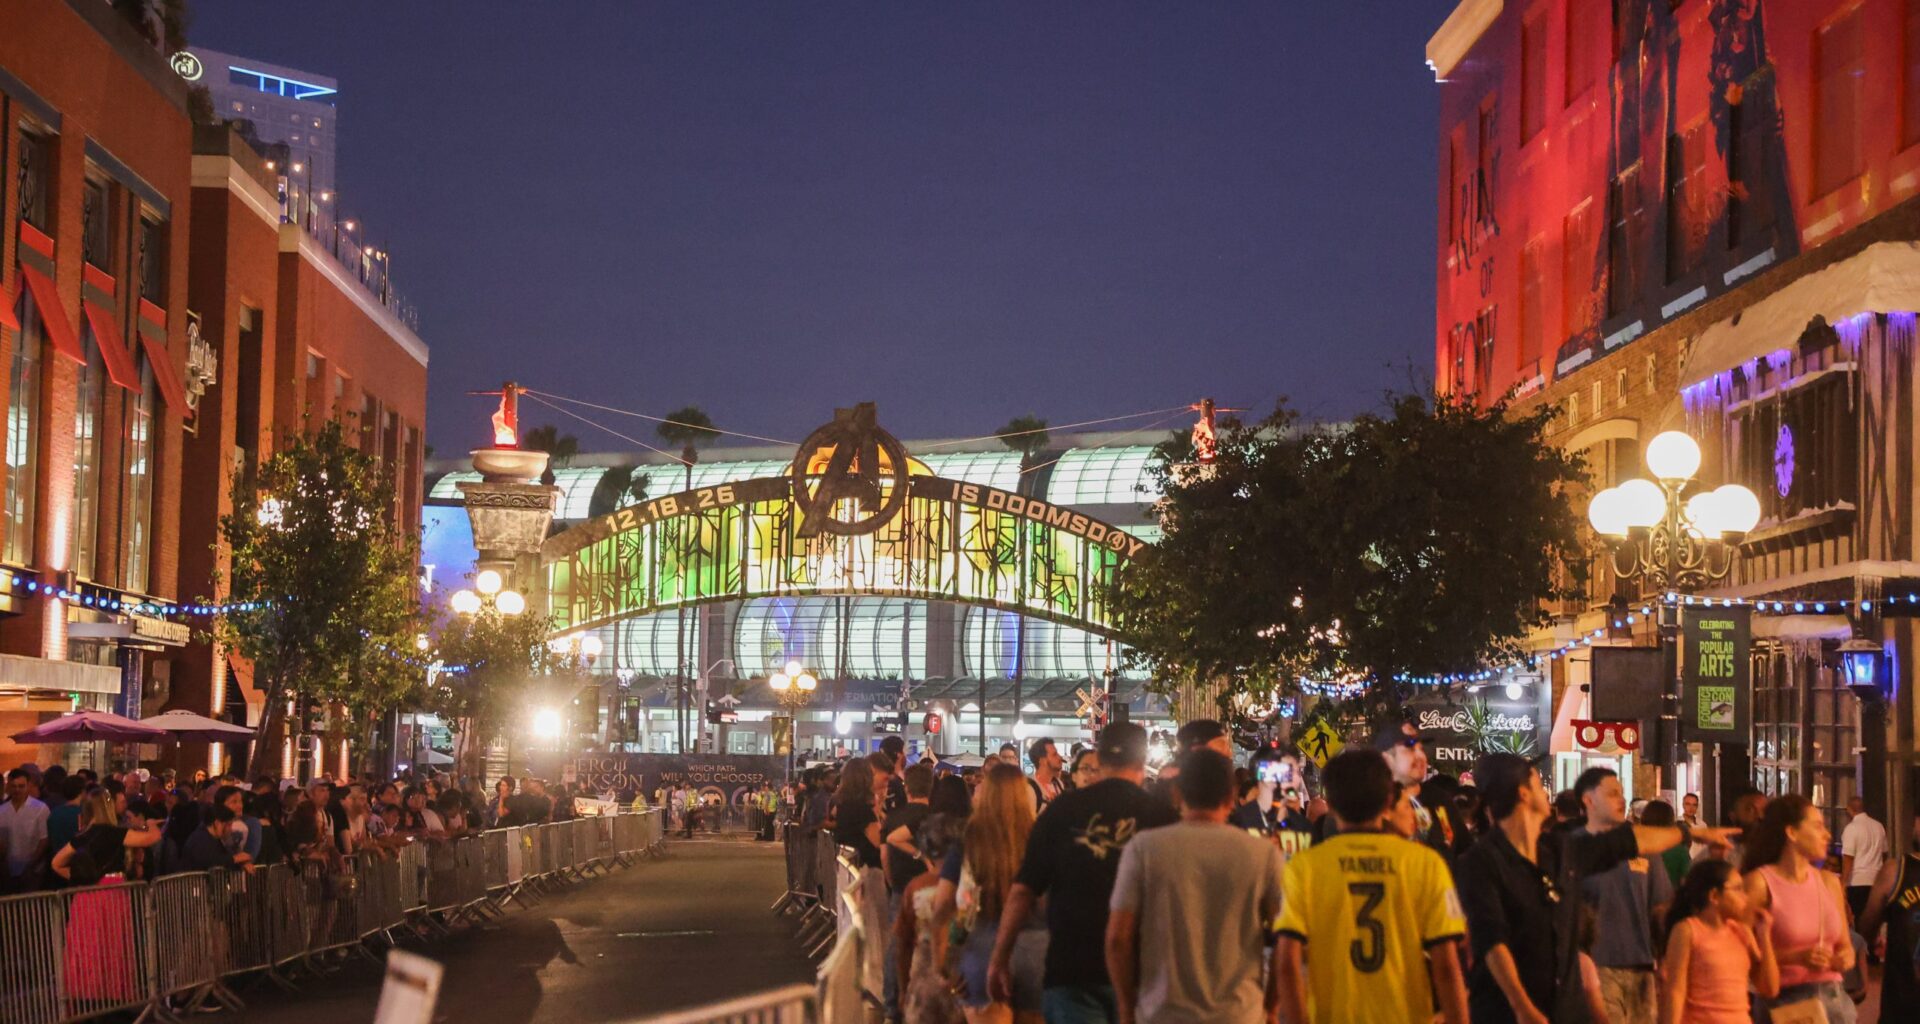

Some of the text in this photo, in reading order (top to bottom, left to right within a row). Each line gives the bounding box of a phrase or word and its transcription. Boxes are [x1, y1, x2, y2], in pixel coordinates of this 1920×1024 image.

[1480, 256, 1494, 298] OF
[952, 482, 980, 504] IS
[1699, 620, 1735, 630] CELEBRATING
[1711, 631, 1722, 639] THE
[1699, 641, 1734, 654] POPULAR
[1699, 654, 1734, 677] ARTS
[824, 693, 899, 703] IERNATION
[1712, 691, 1732, 702] CON
[1419, 710, 1451, 730] Lou
[687, 764, 736, 772] WHICH PATH
[577, 773, 644, 791] KSON
[687, 772, 710, 783] YOU
[713, 772, 764, 783] CHOOSE?
[1338, 856, 1396, 874] YANDEL
[1347, 881, 1387, 974] 3
